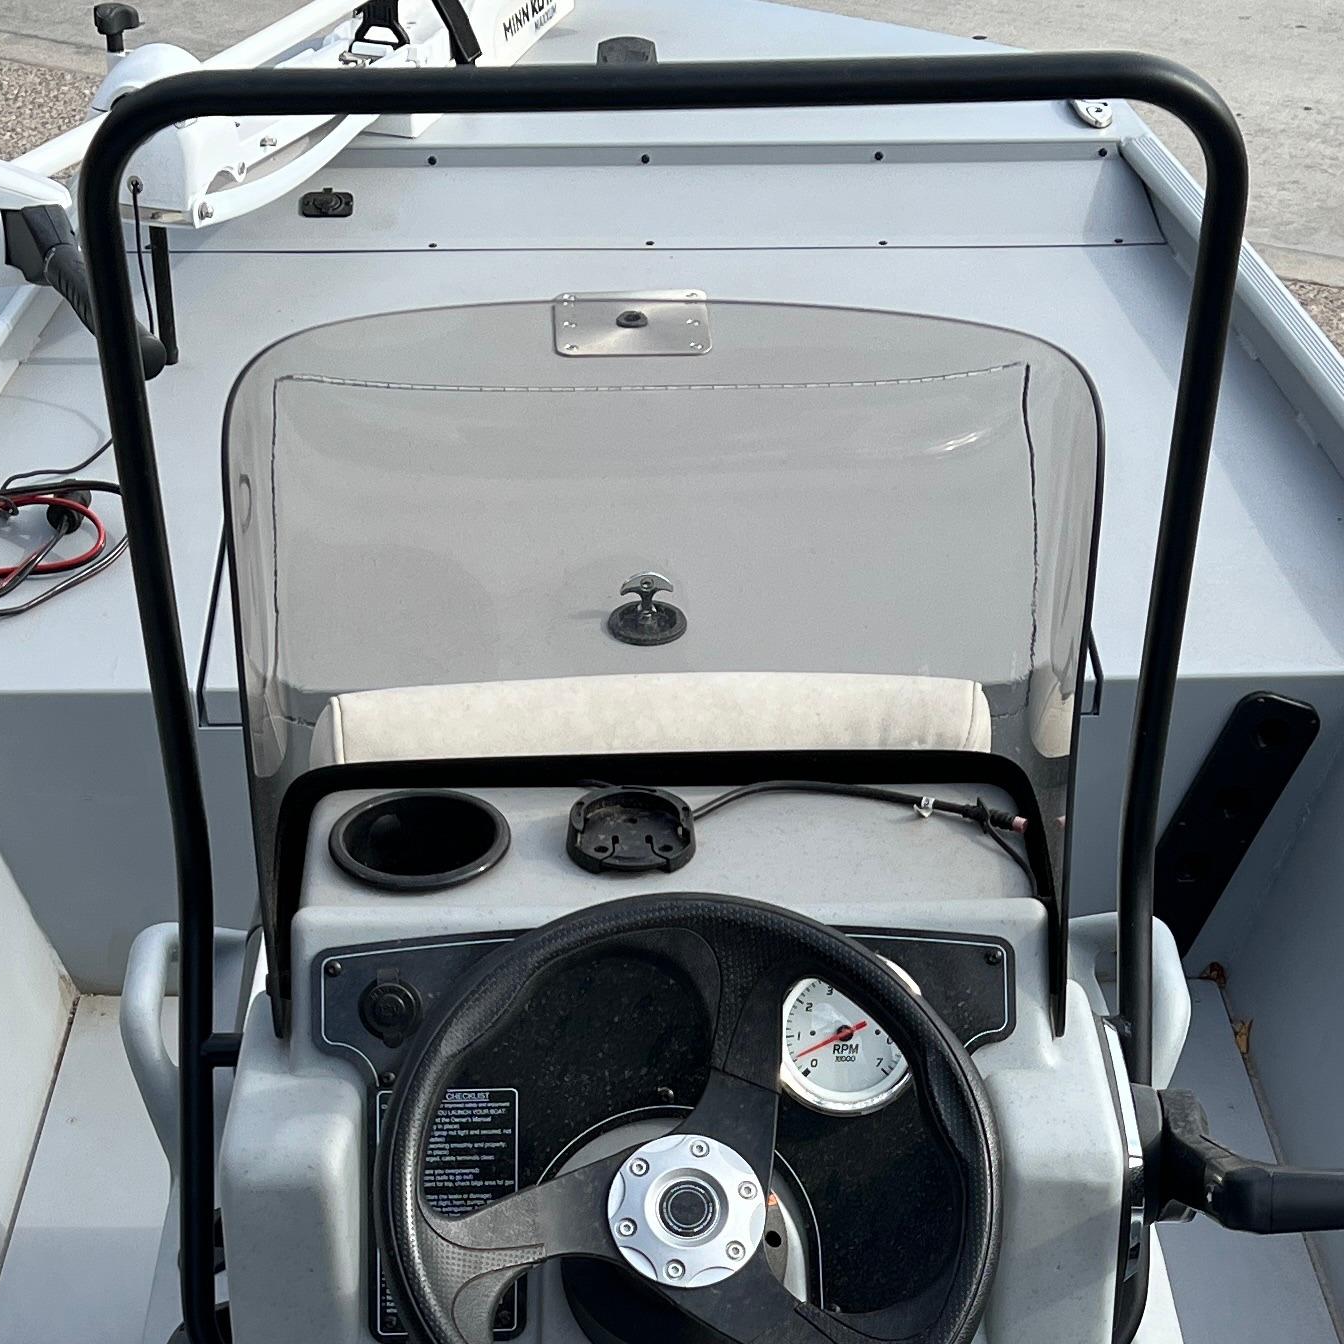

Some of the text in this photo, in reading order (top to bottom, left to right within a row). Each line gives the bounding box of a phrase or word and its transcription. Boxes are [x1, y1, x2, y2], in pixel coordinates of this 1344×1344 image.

[503, 3, 530, 41] MINN
[806, 1003, 813, 1012] 2
[797, 1032, 801, 1041] 1
[833, 1044, 859, 1055] RPM
[810, 1059, 818, 1068] 0
[876, 1058, 884, 1067] 7
[446, 1092, 490, 1100] CHECKLIST
